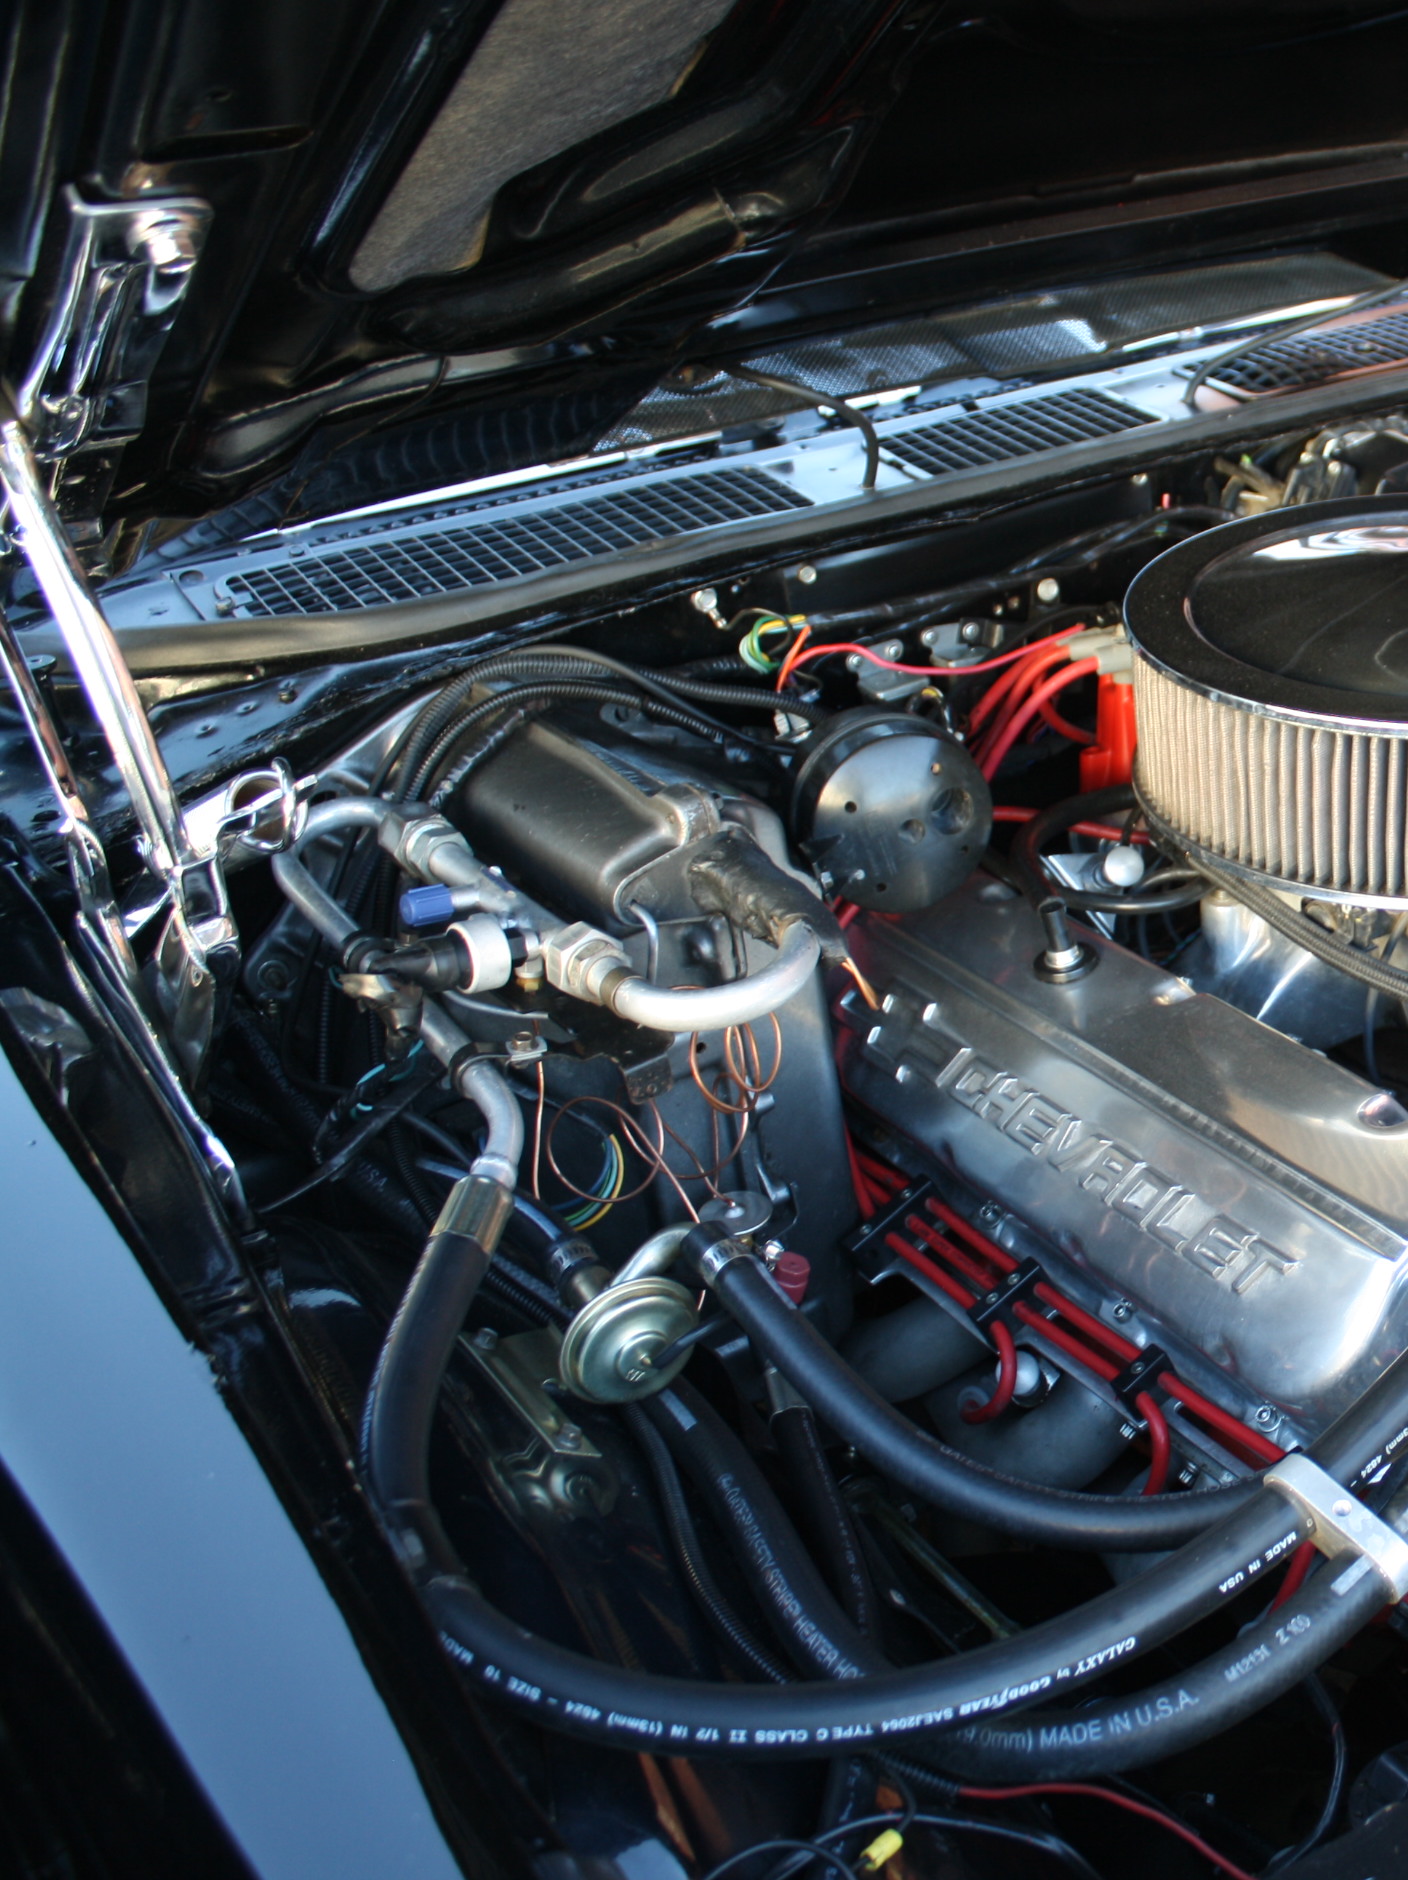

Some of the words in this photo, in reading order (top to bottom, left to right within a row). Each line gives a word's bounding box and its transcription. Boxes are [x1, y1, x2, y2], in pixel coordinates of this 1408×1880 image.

[950, 1064, 1301, 1295] CHEVROLET
[1265, 1531, 1298, 1562] MADE
[1248, 1559, 1262, 1576] IN
[1219, 1571, 1246, 1594] USA
[791, 1613, 841, 1671] HEATER
[1074, 1636, 1138, 1677] GALAXY
[1056, 1667, 1071, 1682] by
[506, 1675, 543, 1701] SIZE
[959, 1676, 1052, 1715] GOODYEAR
[1040, 1722, 1103, 1749] MADE
[1108, 1710, 1132, 1735] IN
[1136, 1688, 1201, 1727] U.S.A.
[669, 1723, 689, 1740] IN
[696, 1726, 720, 1743] 1/2
[755, 1727, 809, 1744] CLASS
[832, 1722, 875, 1741] TYPE
